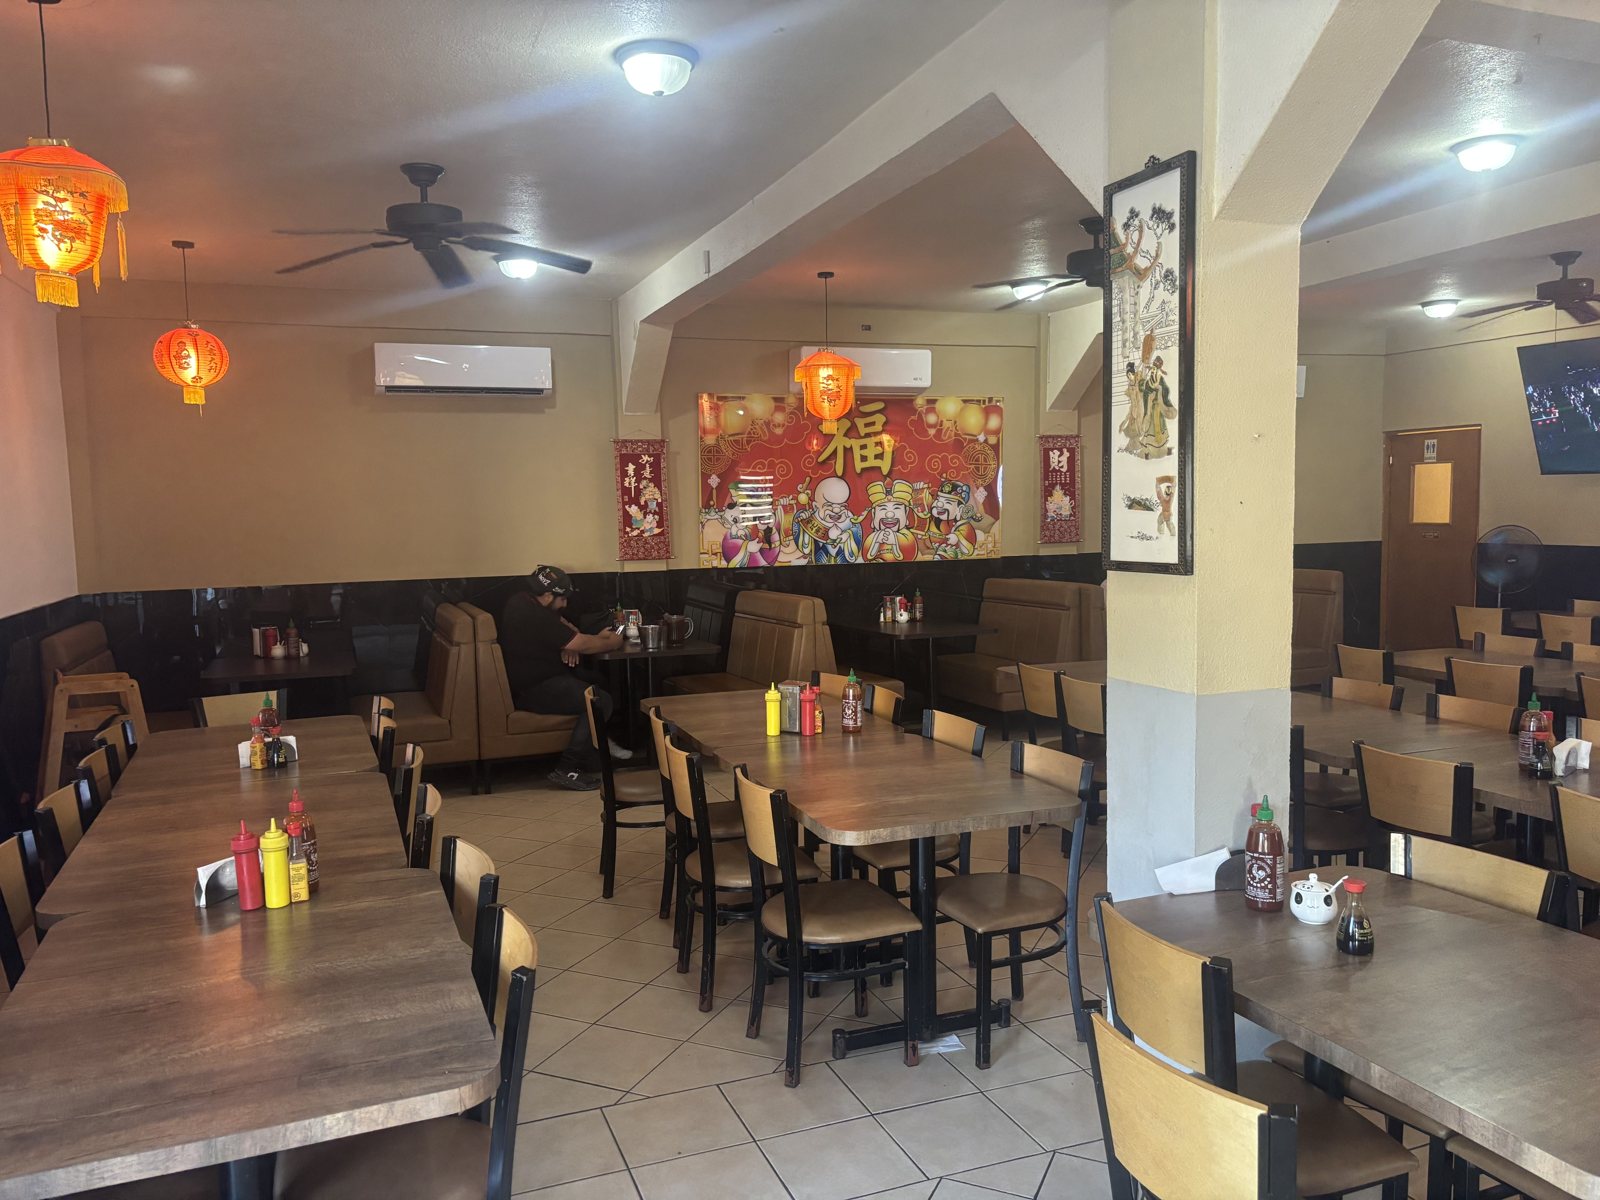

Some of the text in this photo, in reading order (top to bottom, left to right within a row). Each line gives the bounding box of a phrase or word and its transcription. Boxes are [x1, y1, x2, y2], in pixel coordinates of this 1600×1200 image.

[817, 401, 895, 477] 福
[639, 454, 654, 478] 如意
[1049, 448, 1070, 472] 財
[624, 462, 638, 497] 吉祥
